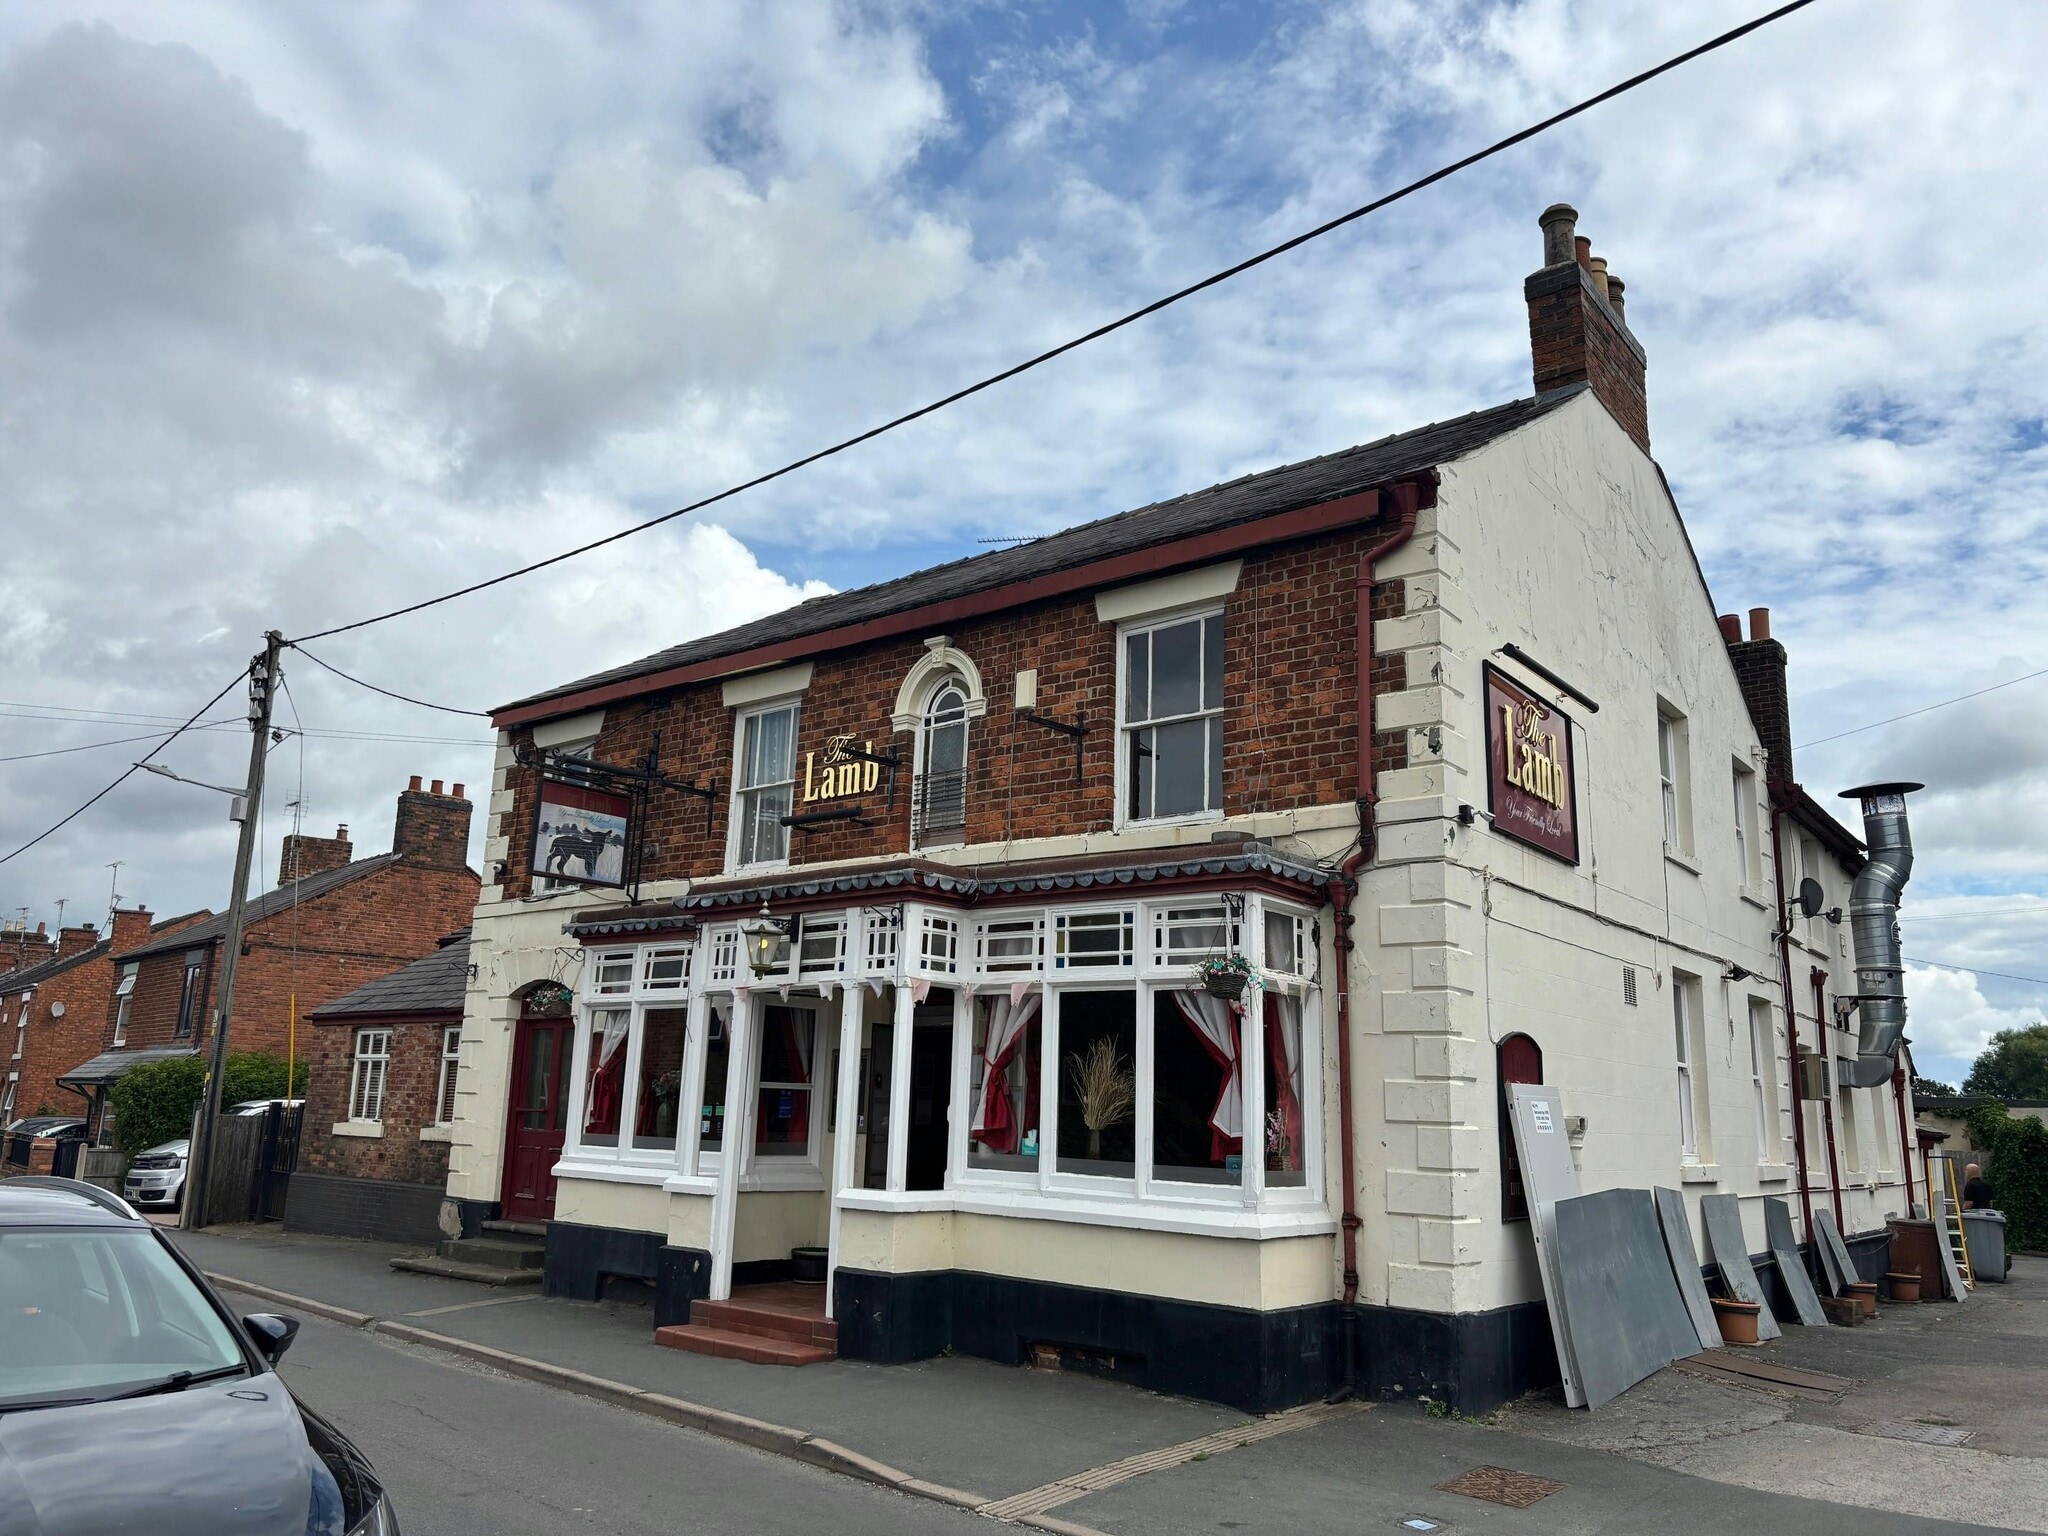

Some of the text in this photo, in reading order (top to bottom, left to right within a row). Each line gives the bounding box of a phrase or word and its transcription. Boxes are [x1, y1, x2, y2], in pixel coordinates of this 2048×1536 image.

[1521, 699, 1546, 747] The
[803, 741, 879, 802] Lamb
[823, 733, 857, 764] The
[1504, 704, 1565, 810] Lamb
[1505, 795, 1522, 819] Your
